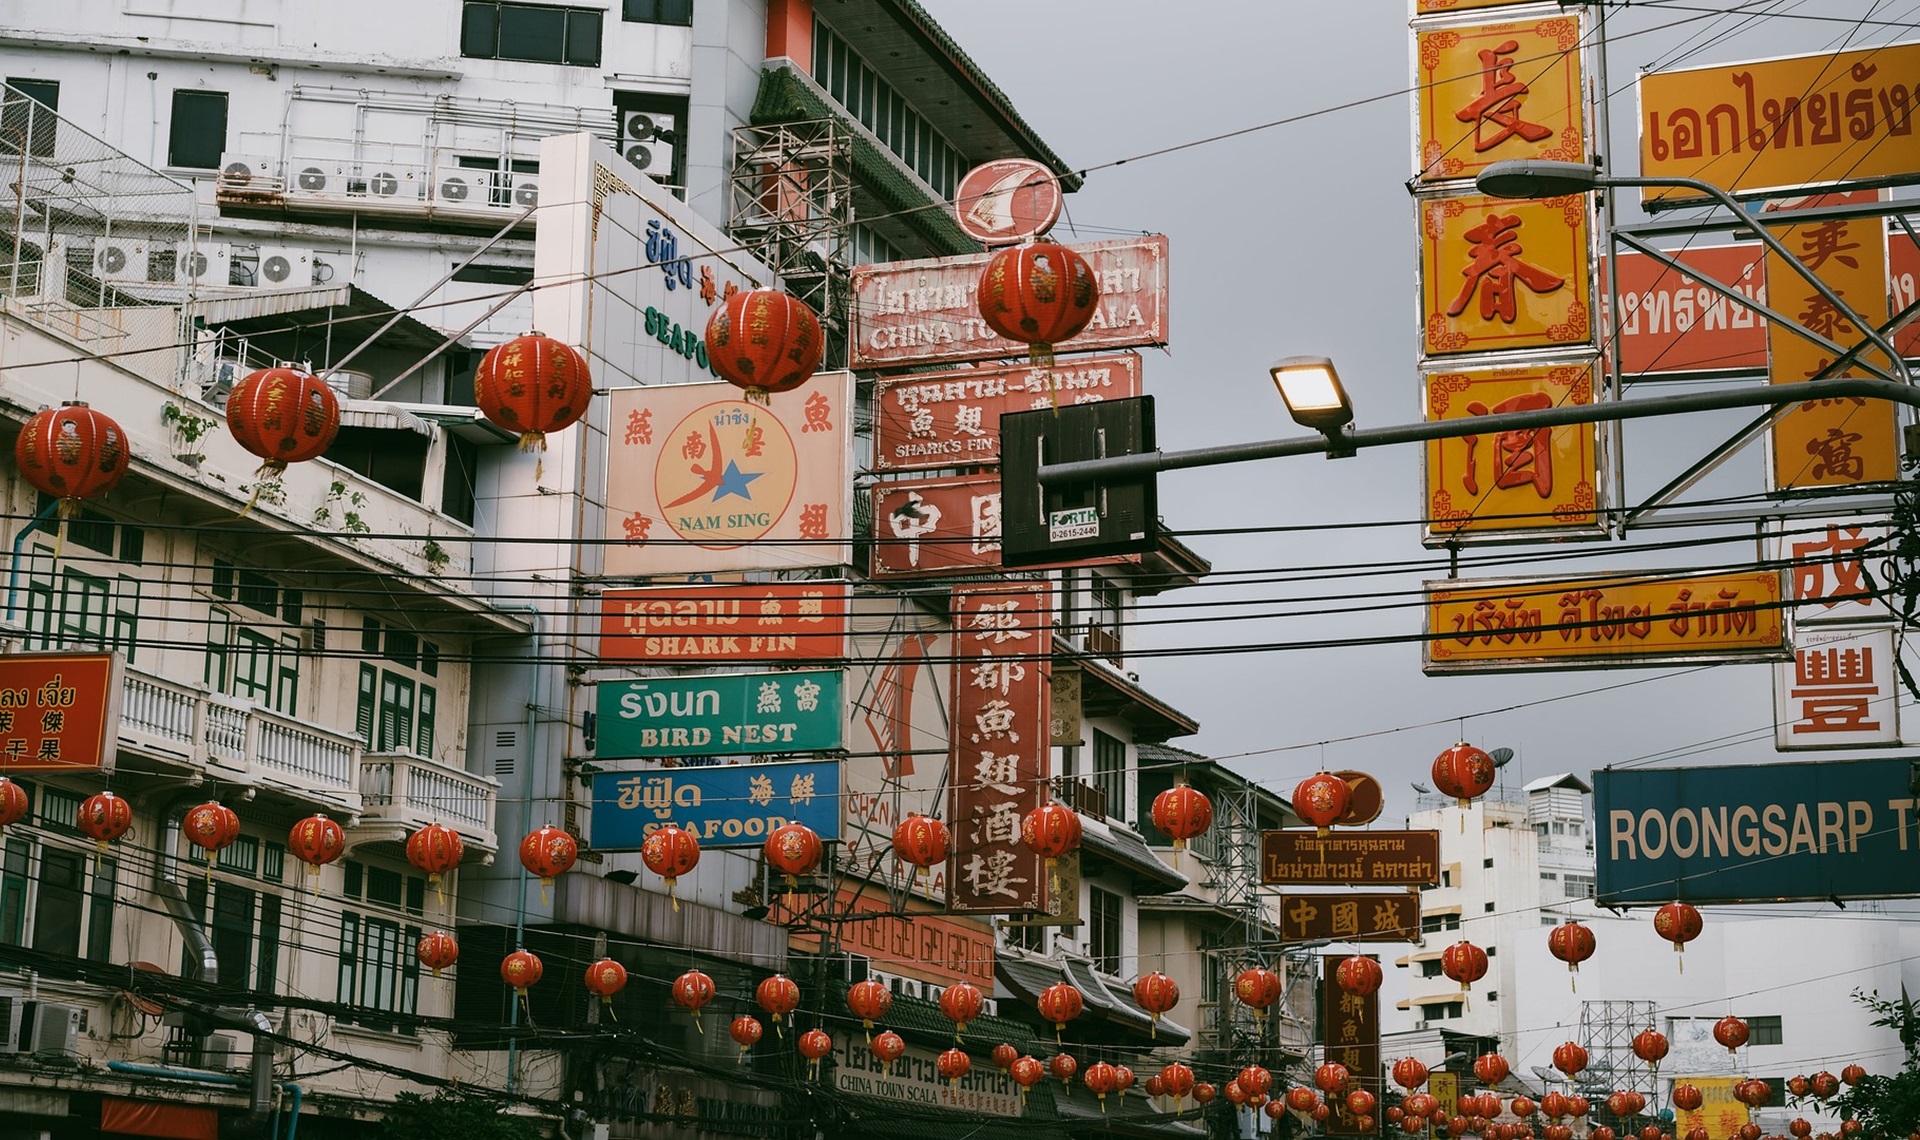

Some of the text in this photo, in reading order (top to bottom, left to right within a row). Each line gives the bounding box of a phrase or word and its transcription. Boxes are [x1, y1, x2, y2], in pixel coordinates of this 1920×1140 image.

[1650, 62, 1920, 161] เอกไทยรัง
[869, 322, 953, 350] CHINA
[625, 408, 653, 445] 燕
[801, 390, 832, 433] 魚
[895, 438, 993, 459] SHARK'S FIN
[680, 512, 770, 531] NAM SING
[624, 599, 740, 639] หูฉลาม
[1452, 599, 1541, 646] บริษัท
[1665, 588, 1756, 638] จำกัด
[645, 633, 797, 656] SHARK FIN
[619, 683, 720, 719] รังนก
[757, 679, 821, 714] 燕窩
[641, 723, 797, 747] BIRD NEST
[749, 773, 816, 806] 海鮮
[1610, 801, 1873, 860] ROONGSARP
[1290, 899, 1406, 937] 中國城
[841, 1074, 938, 1104] CHINA TOWN SCALA
